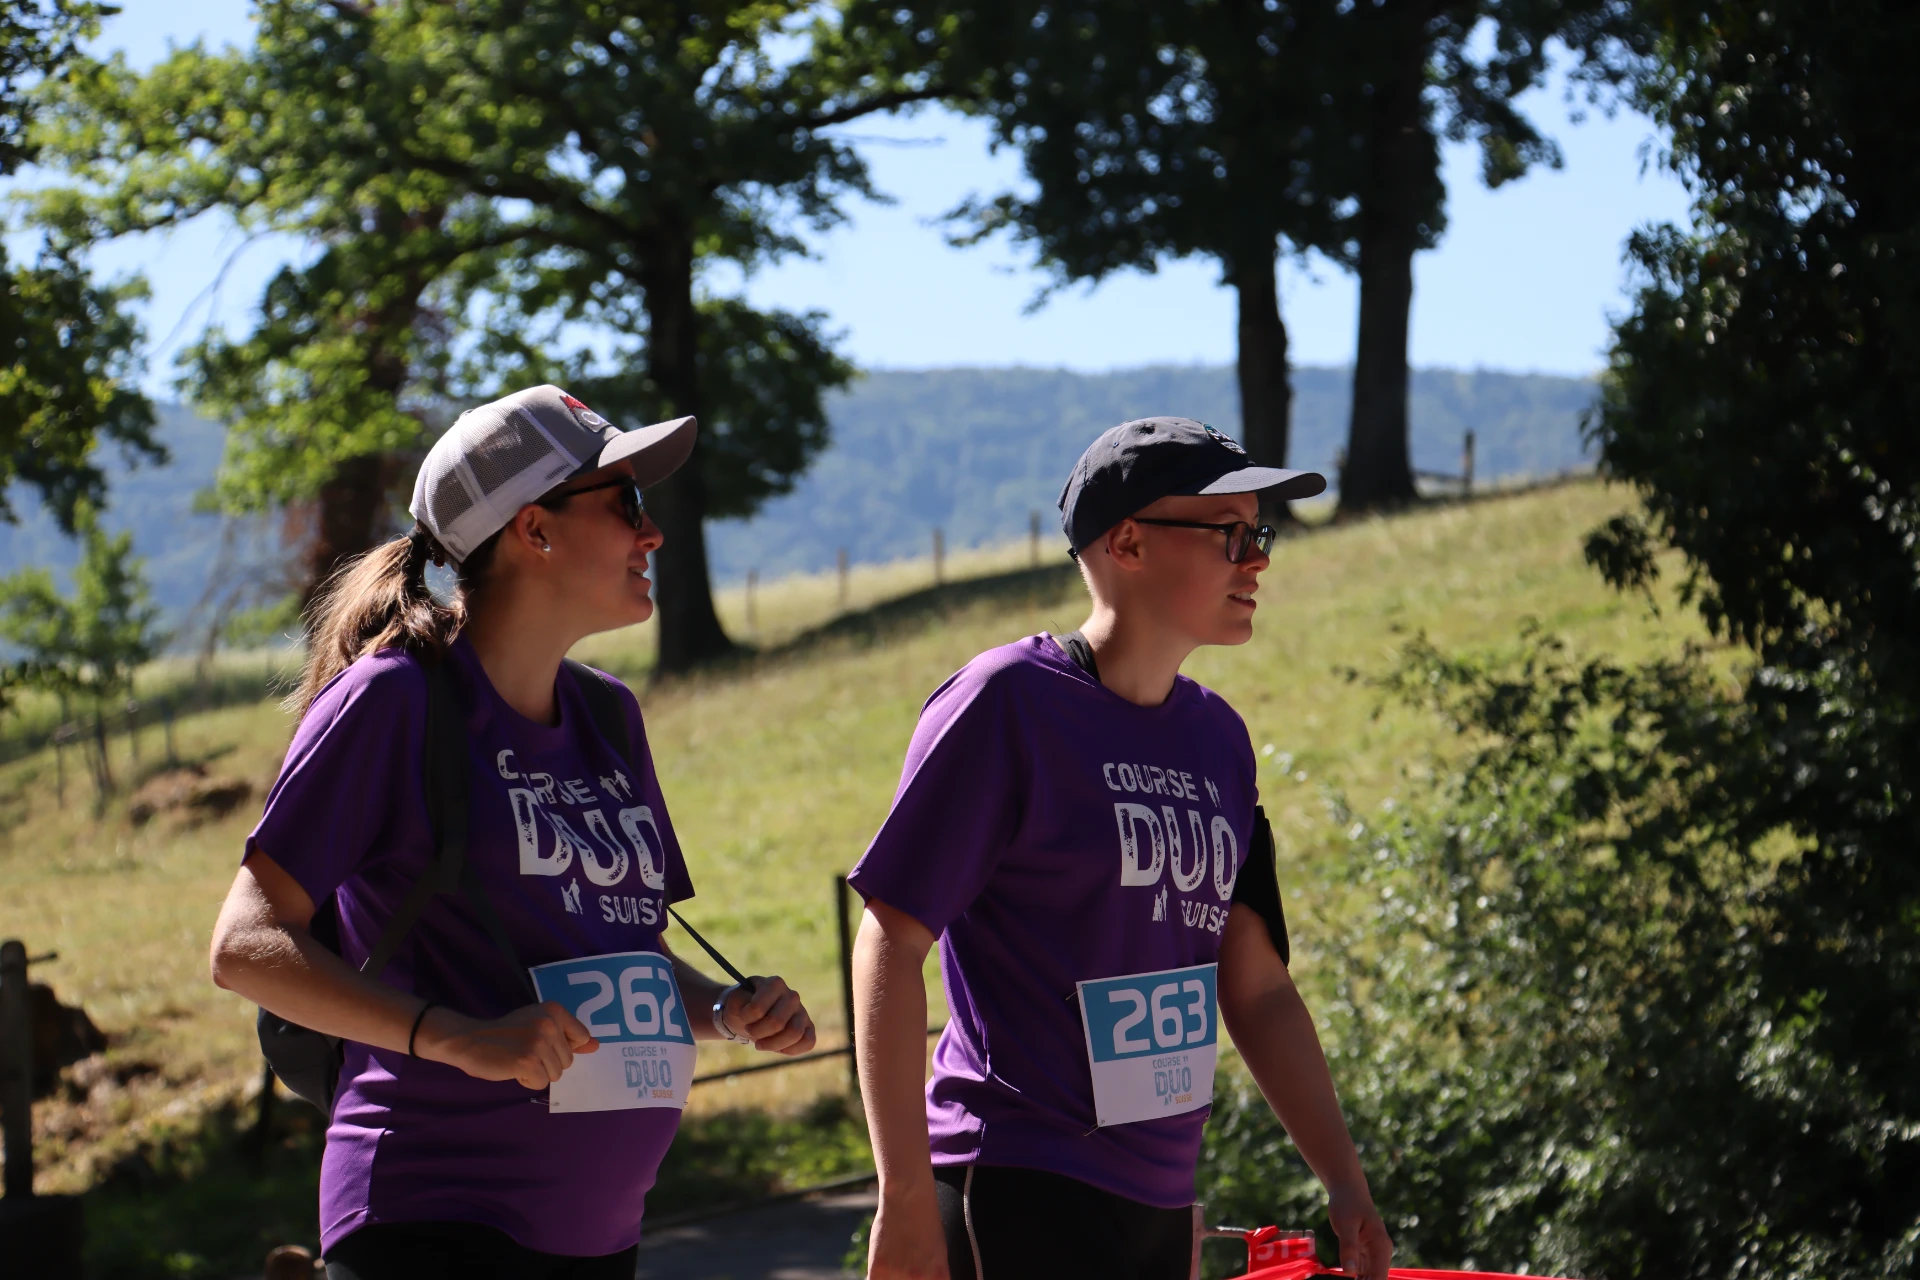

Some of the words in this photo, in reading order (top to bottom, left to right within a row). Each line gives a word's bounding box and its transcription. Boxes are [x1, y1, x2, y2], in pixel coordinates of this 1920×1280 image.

[1103, 762, 1200, 802] COURSE
[508, 787, 665, 891] DUO
[1114, 802, 1238, 901] DUO
[598, 894, 663, 925] SUIS
[567, 966, 684, 1038] 262
[1108, 979, 1208, 1055] 263
[621, 1046, 658, 1057] COURSE
[1152, 1055, 1181, 1069] COURSE
[624, 1059, 673, 1088] DUO
[1154, 1066, 1192, 1097] DUO
[651, 1089, 674, 1099] SUISSE
[1174, 1093, 1193, 1105] SUISSE
